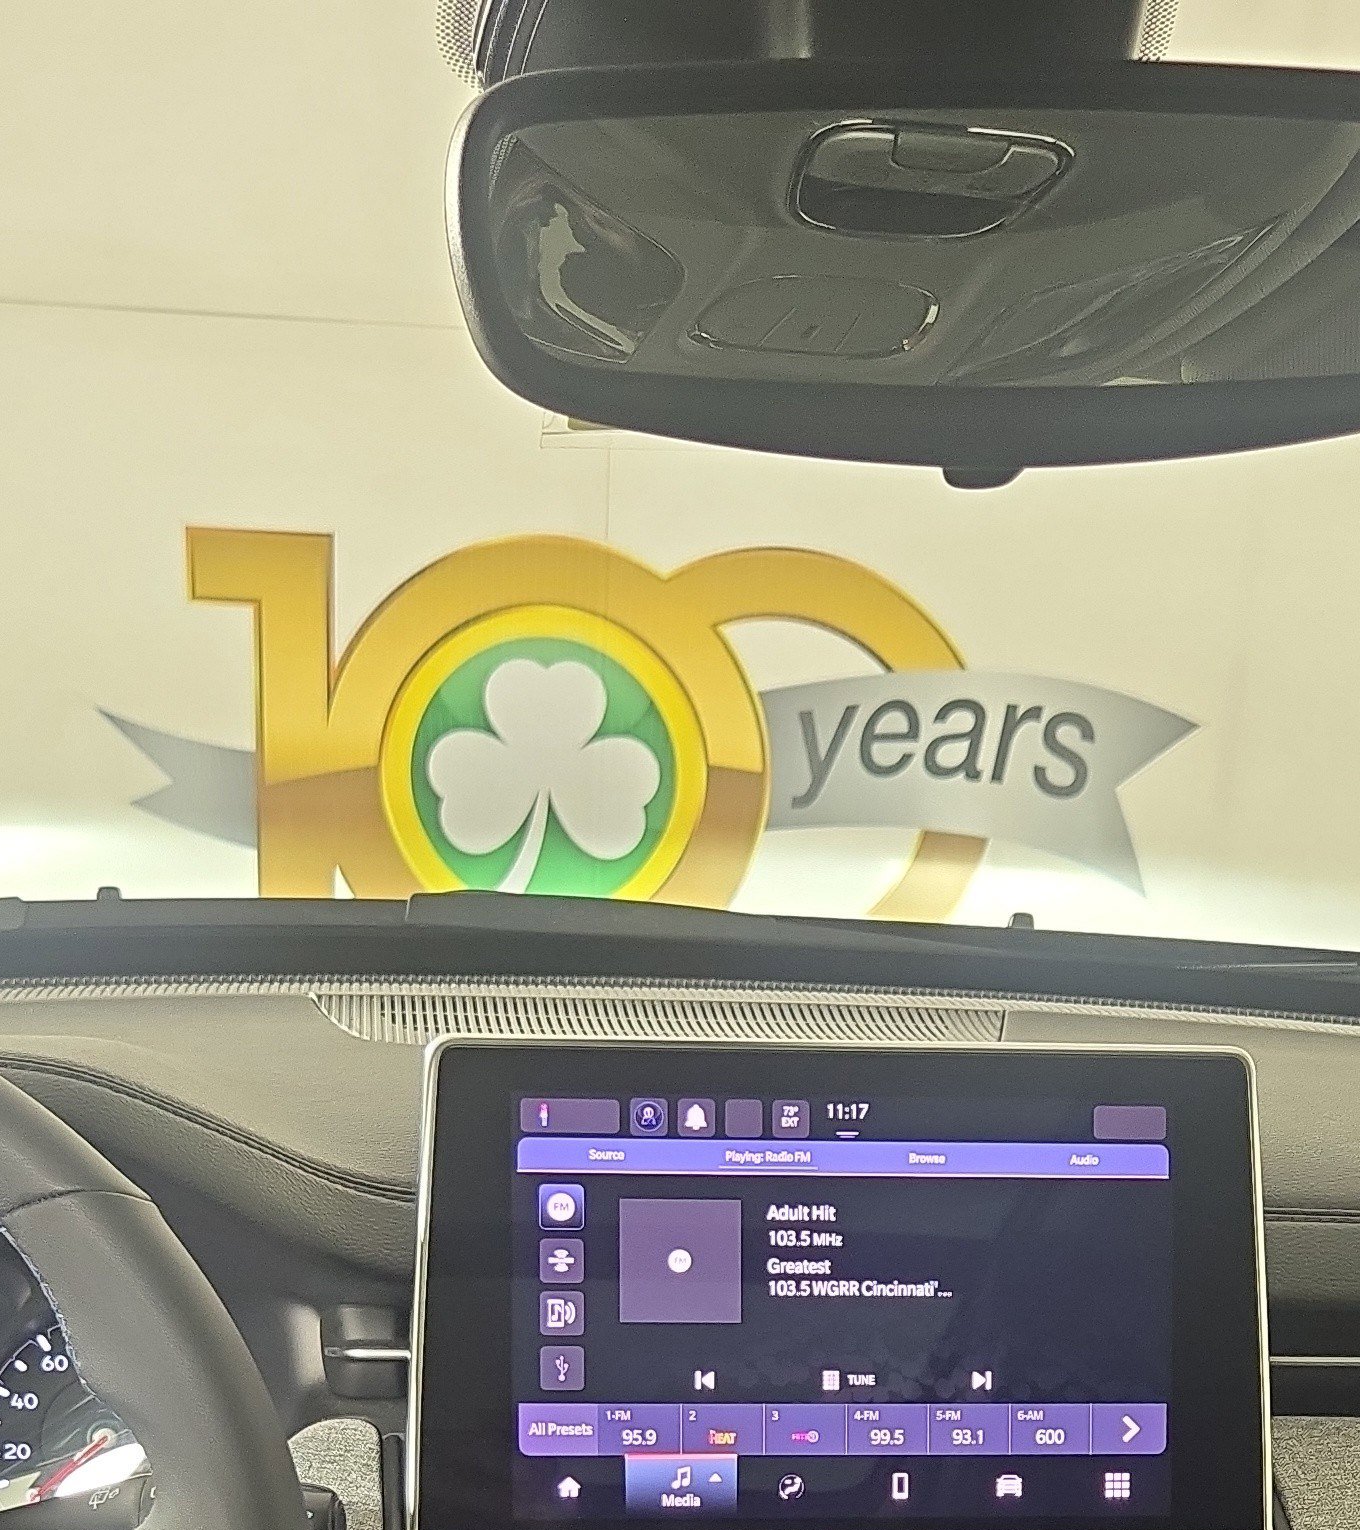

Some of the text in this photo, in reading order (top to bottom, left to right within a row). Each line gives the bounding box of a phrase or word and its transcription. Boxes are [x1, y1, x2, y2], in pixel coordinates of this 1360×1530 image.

[792, 698, 1095, 808] years
[826, 1103, 869, 1121] 11:17
[781, 1117, 799, 1128] EXT
[588, 1149, 625, 1161] Source
[725, 1151, 811, 1164] Playing: Radio FM
[908, 1152, 946, 1165] Browse
[1069, 1154, 1100, 1166] Audio
[552, 1202, 569, 1213] FM
[767, 1204, 836, 1222] Adult Hit
[768, 1230, 843, 1247] 103.5 MHz
[767, 1258, 831, 1275] Greatest
[768, 1280, 810, 1297] 103.5
[812, 1280, 860, 1297] WGRR
[41, 1354, 69, 1373] 60
[847, 1374, 876, 1386] TUNE
[10, 1393, 39, 1411] 40
[688, 1410, 697, 1421] 2
[771, 1410, 779, 1421] 3
[853, 1410, 879, 1421] 4-FM
[936, 1410, 961, 1421] 5-FM
[1017, 1410, 1044, 1421] 6-AM
[528, 1422, 593, 1437] All Presets
[621, 1429, 657, 1446] 95.9
[869, 1429, 905, 1446] 99.5
[952, 1429, 984, 1446] 93.1
[1035, 1429, 1065, 1446] 600
[3, 1444, 32, 1461] 20
[662, 1494, 700, 1508] Media
